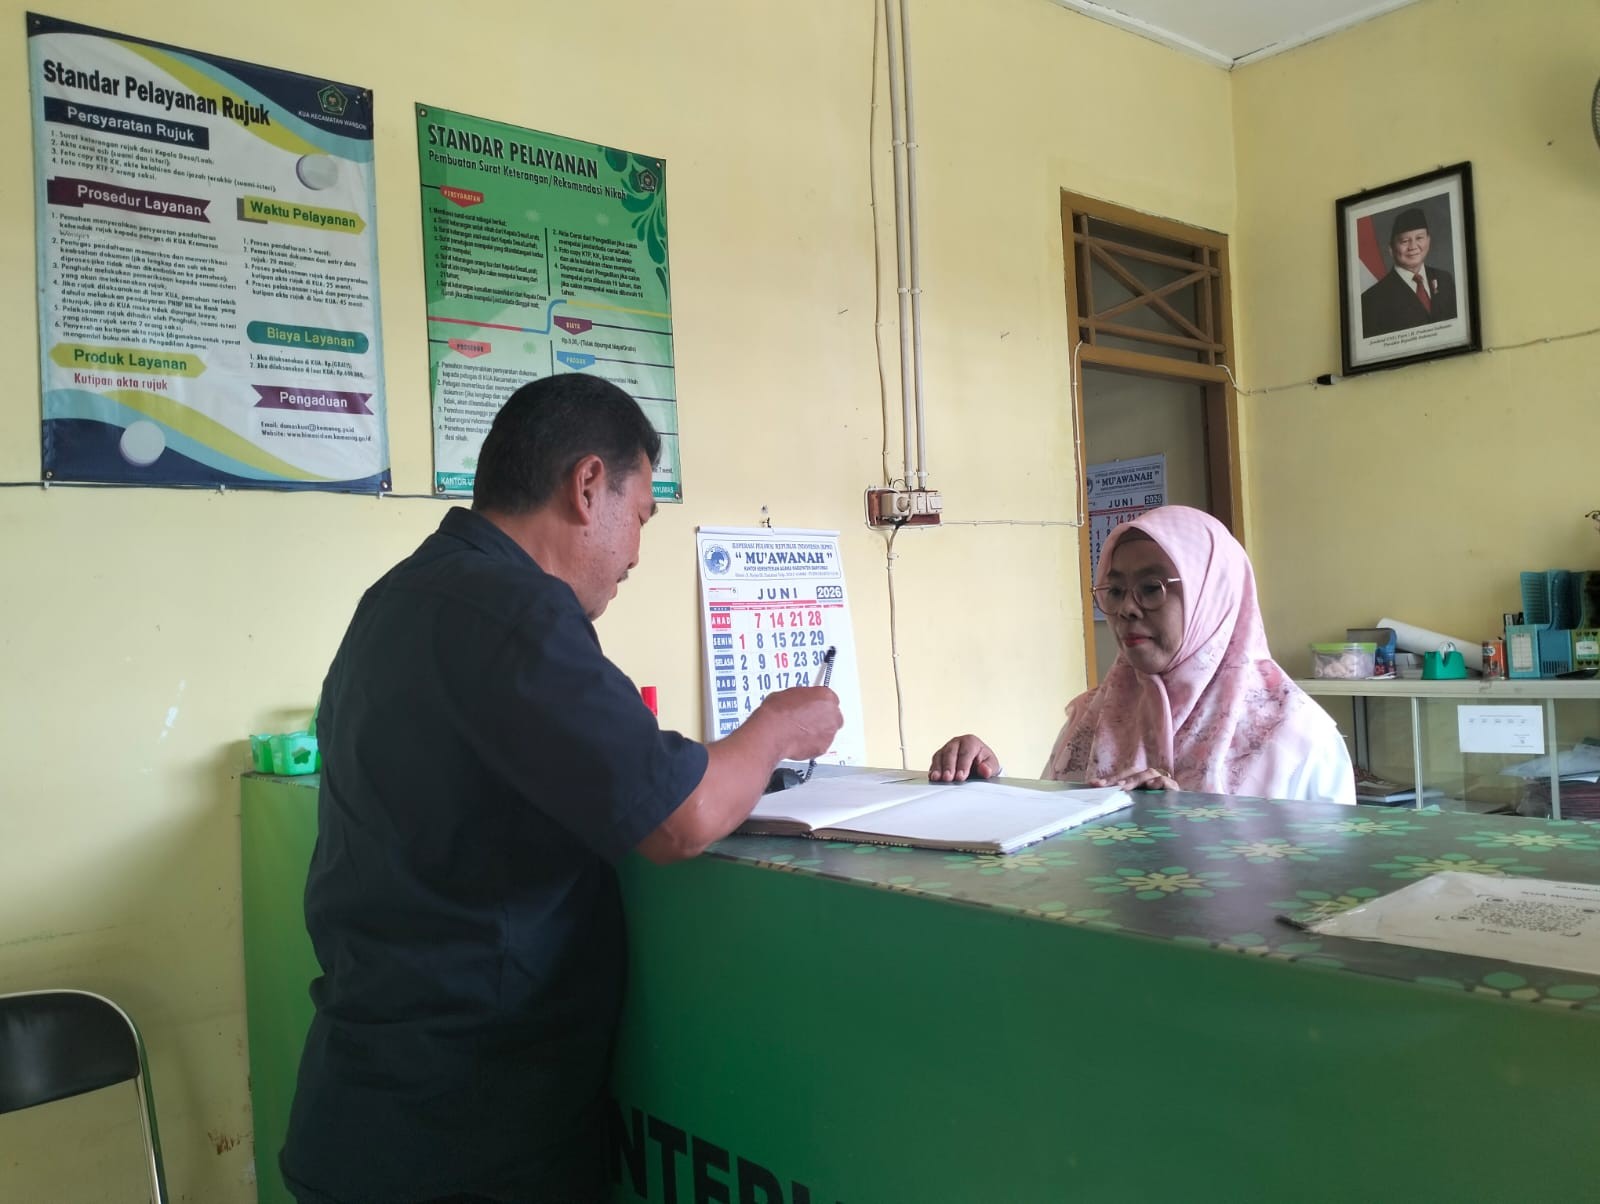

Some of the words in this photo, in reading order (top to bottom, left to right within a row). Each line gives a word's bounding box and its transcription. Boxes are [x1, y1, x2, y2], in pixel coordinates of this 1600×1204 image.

[42, 58, 119, 97] Standar
[124, 75, 217, 116] Pelayanan
[221, 95, 270, 127] Rujuk
[67, 106, 152, 134] Persyaratan
[156, 122, 194, 144] Rujuk
[427, 123, 504, 160] STANDAR
[509, 141, 598, 180] PELAYANAN
[428, 149, 476, 170] Pembuatan
[478, 159, 501, 175] Surat
[502, 165, 602, 196] Keterangan/Rekomendasi
[604, 186, 626, 200] Nikah
[77, 184, 140, 207] Prosedur
[144, 196, 201, 217] Layanan
[250, 200, 289, 218] Waktu
[292, 207, 355, 229] Pelayanan
[266, 326, 300, 344] Biaya
[304, 330, 354, 348] Layanan
[73, 349, 123, 365] Produk
[128, 354, 187, 372] Layanan
[74, 372, 112, 387] Kutipan
[116, 375, 138, 388] akta
[141, 377, 168, 391] rujuk
[279, 391, 347, 408] Pengaduan
[1109, 498, 1133, 508] JUNI
[1107, 517, 1110, 526] 7
[1116, 515, 1124, 524] 14
[758, 587, 798, 599] JUNI
[817, 586, 842, 598] 2026
[712, 616, 731, 624] AHAD
[755, 613, 761, 628] 7
[770, 612, 784, 628] 14
[790, 611, 803, 626] 21
[808, 611, 822, 626] 28
[739, 634, 745, 649] 1
[757, 633, 763, 648] 8
[772, 633, 786, 647] 15
[791, 632, 806, 646] 22
[810, 631, 824, 645] 29
[741, 655, 747, 670] 2
[759, 654, 766, 669] 9
[774, 653, 788, 668] 16
[794, 652, 807, 667] 23
[813, 651, 825, 666] 30
[716, 679, 736, 688] RABU
[743, 676, 749, 691] 3
[757, 674, 771, 690] 10
[776, 673, 790, 688] 17
[795, 672, 809, 687] 24
[718, 701, 738, 709] KAMIS
[745, 696, 751, 712] 4
